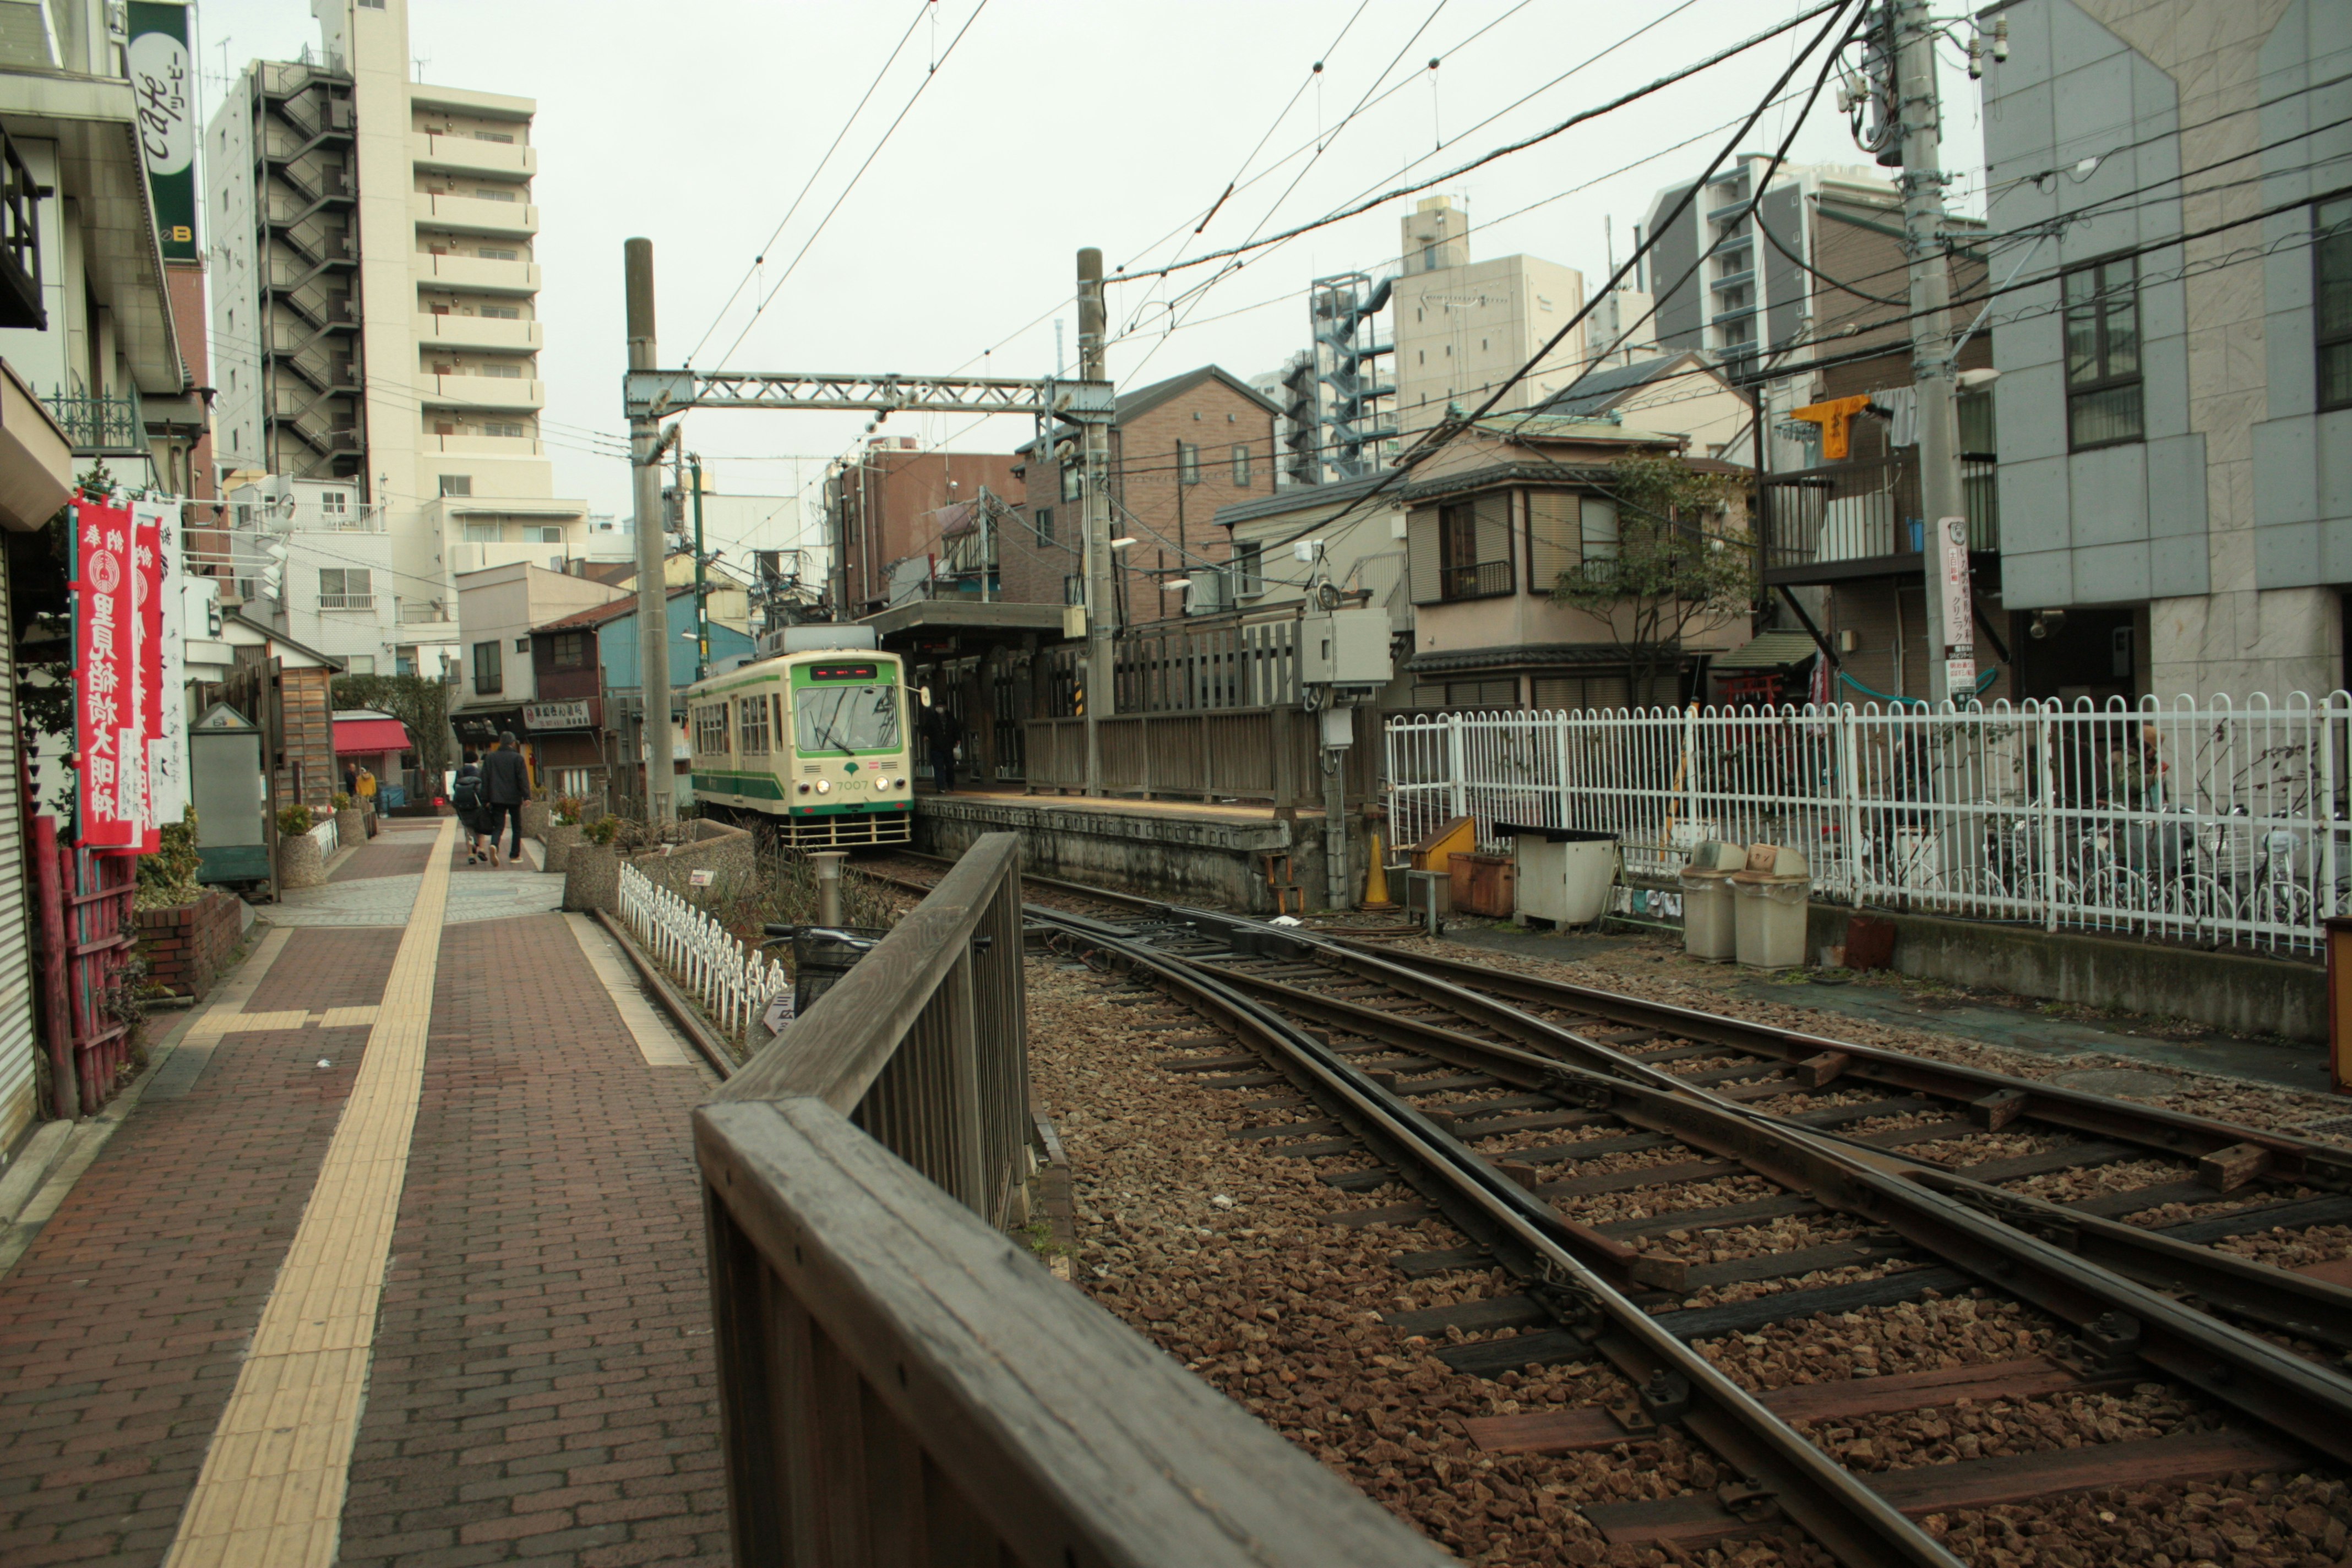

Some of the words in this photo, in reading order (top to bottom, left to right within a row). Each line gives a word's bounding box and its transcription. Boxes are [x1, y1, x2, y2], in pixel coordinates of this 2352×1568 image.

[1952, 596, 1963, 643] クリニック
[836, 780, 868, 791] 7007
